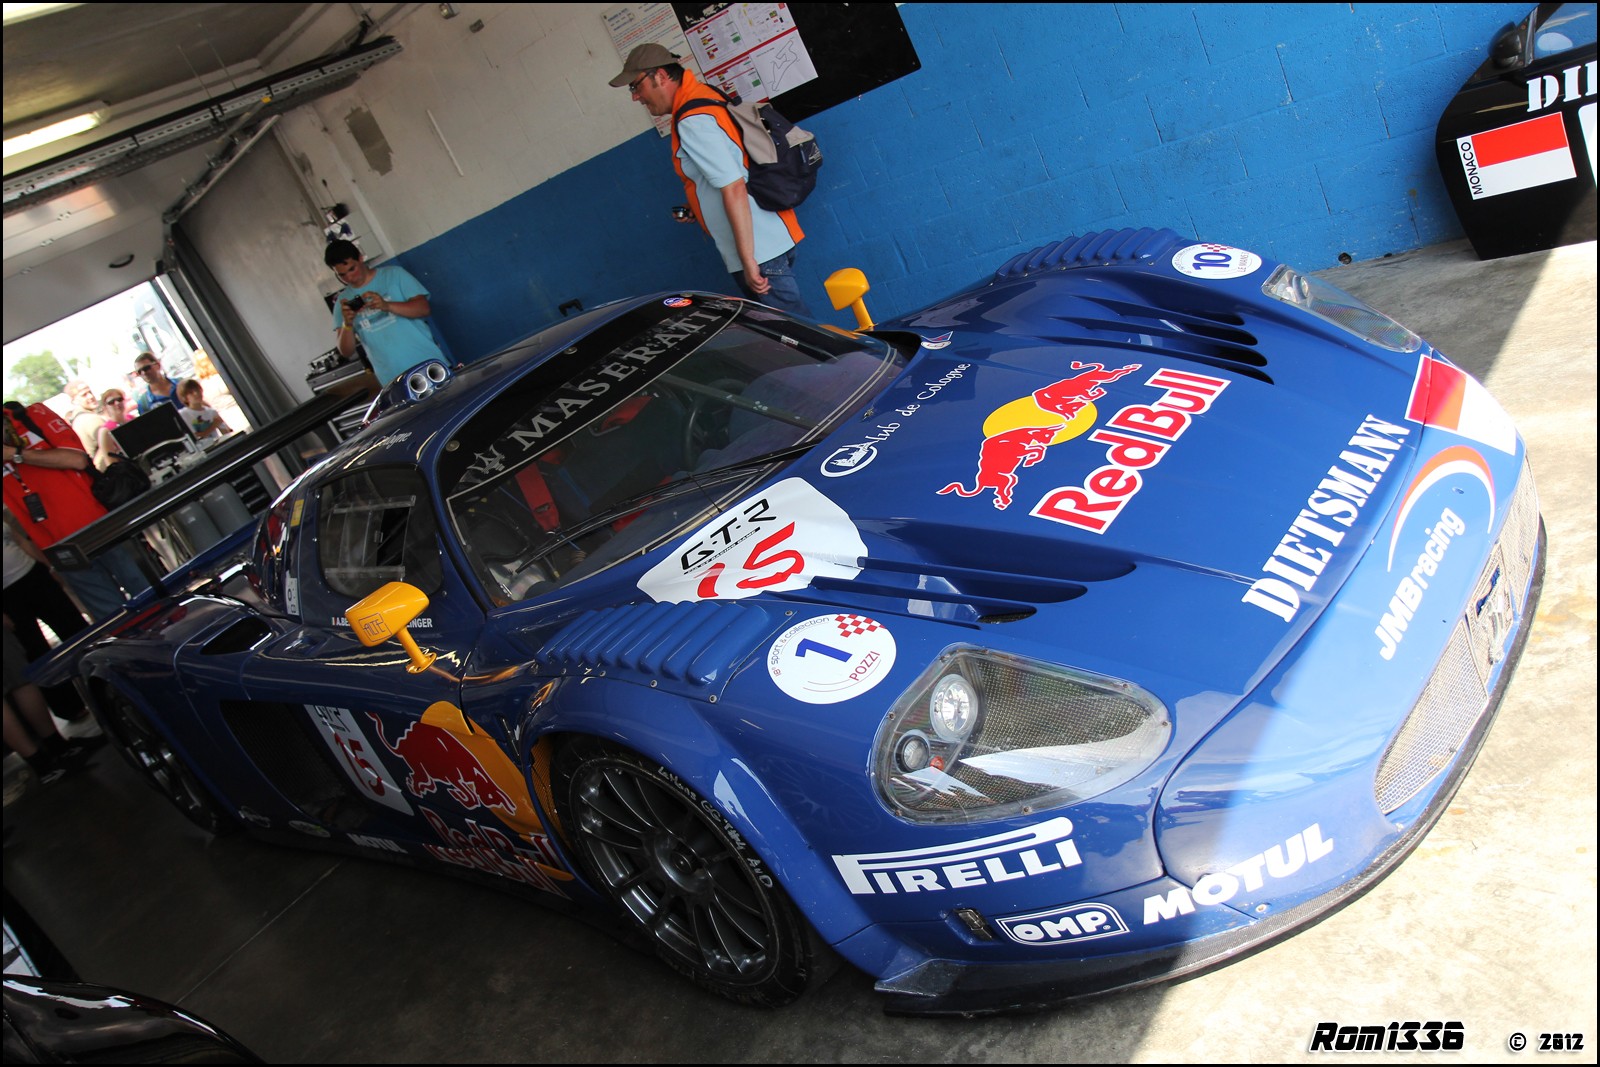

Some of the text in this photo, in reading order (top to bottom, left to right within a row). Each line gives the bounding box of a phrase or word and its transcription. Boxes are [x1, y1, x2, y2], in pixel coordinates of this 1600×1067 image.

[1460, 141, 1483, 195] MONACO
[1192, 252, 1232, 270] 10
[507, 310, 722, 452] MASERATI
[895, 403, 921, 417] de
[917, 363, 971, 400] Cologne
[1241, 414, 1410, 623] DIETSMANN
[694, 521, 805, 598] 15
[771, 644, 783, 665] sport
[784, 617, 830, 639] collection
[795, 638, 853, 663] 1
[850, 650, 881, 682] POZZI
[347, 833, 408, 854] MOTUL
[831, 816, 1082, 895] PIRELLI
[1143, 823, 1333, 925] MOTUL
